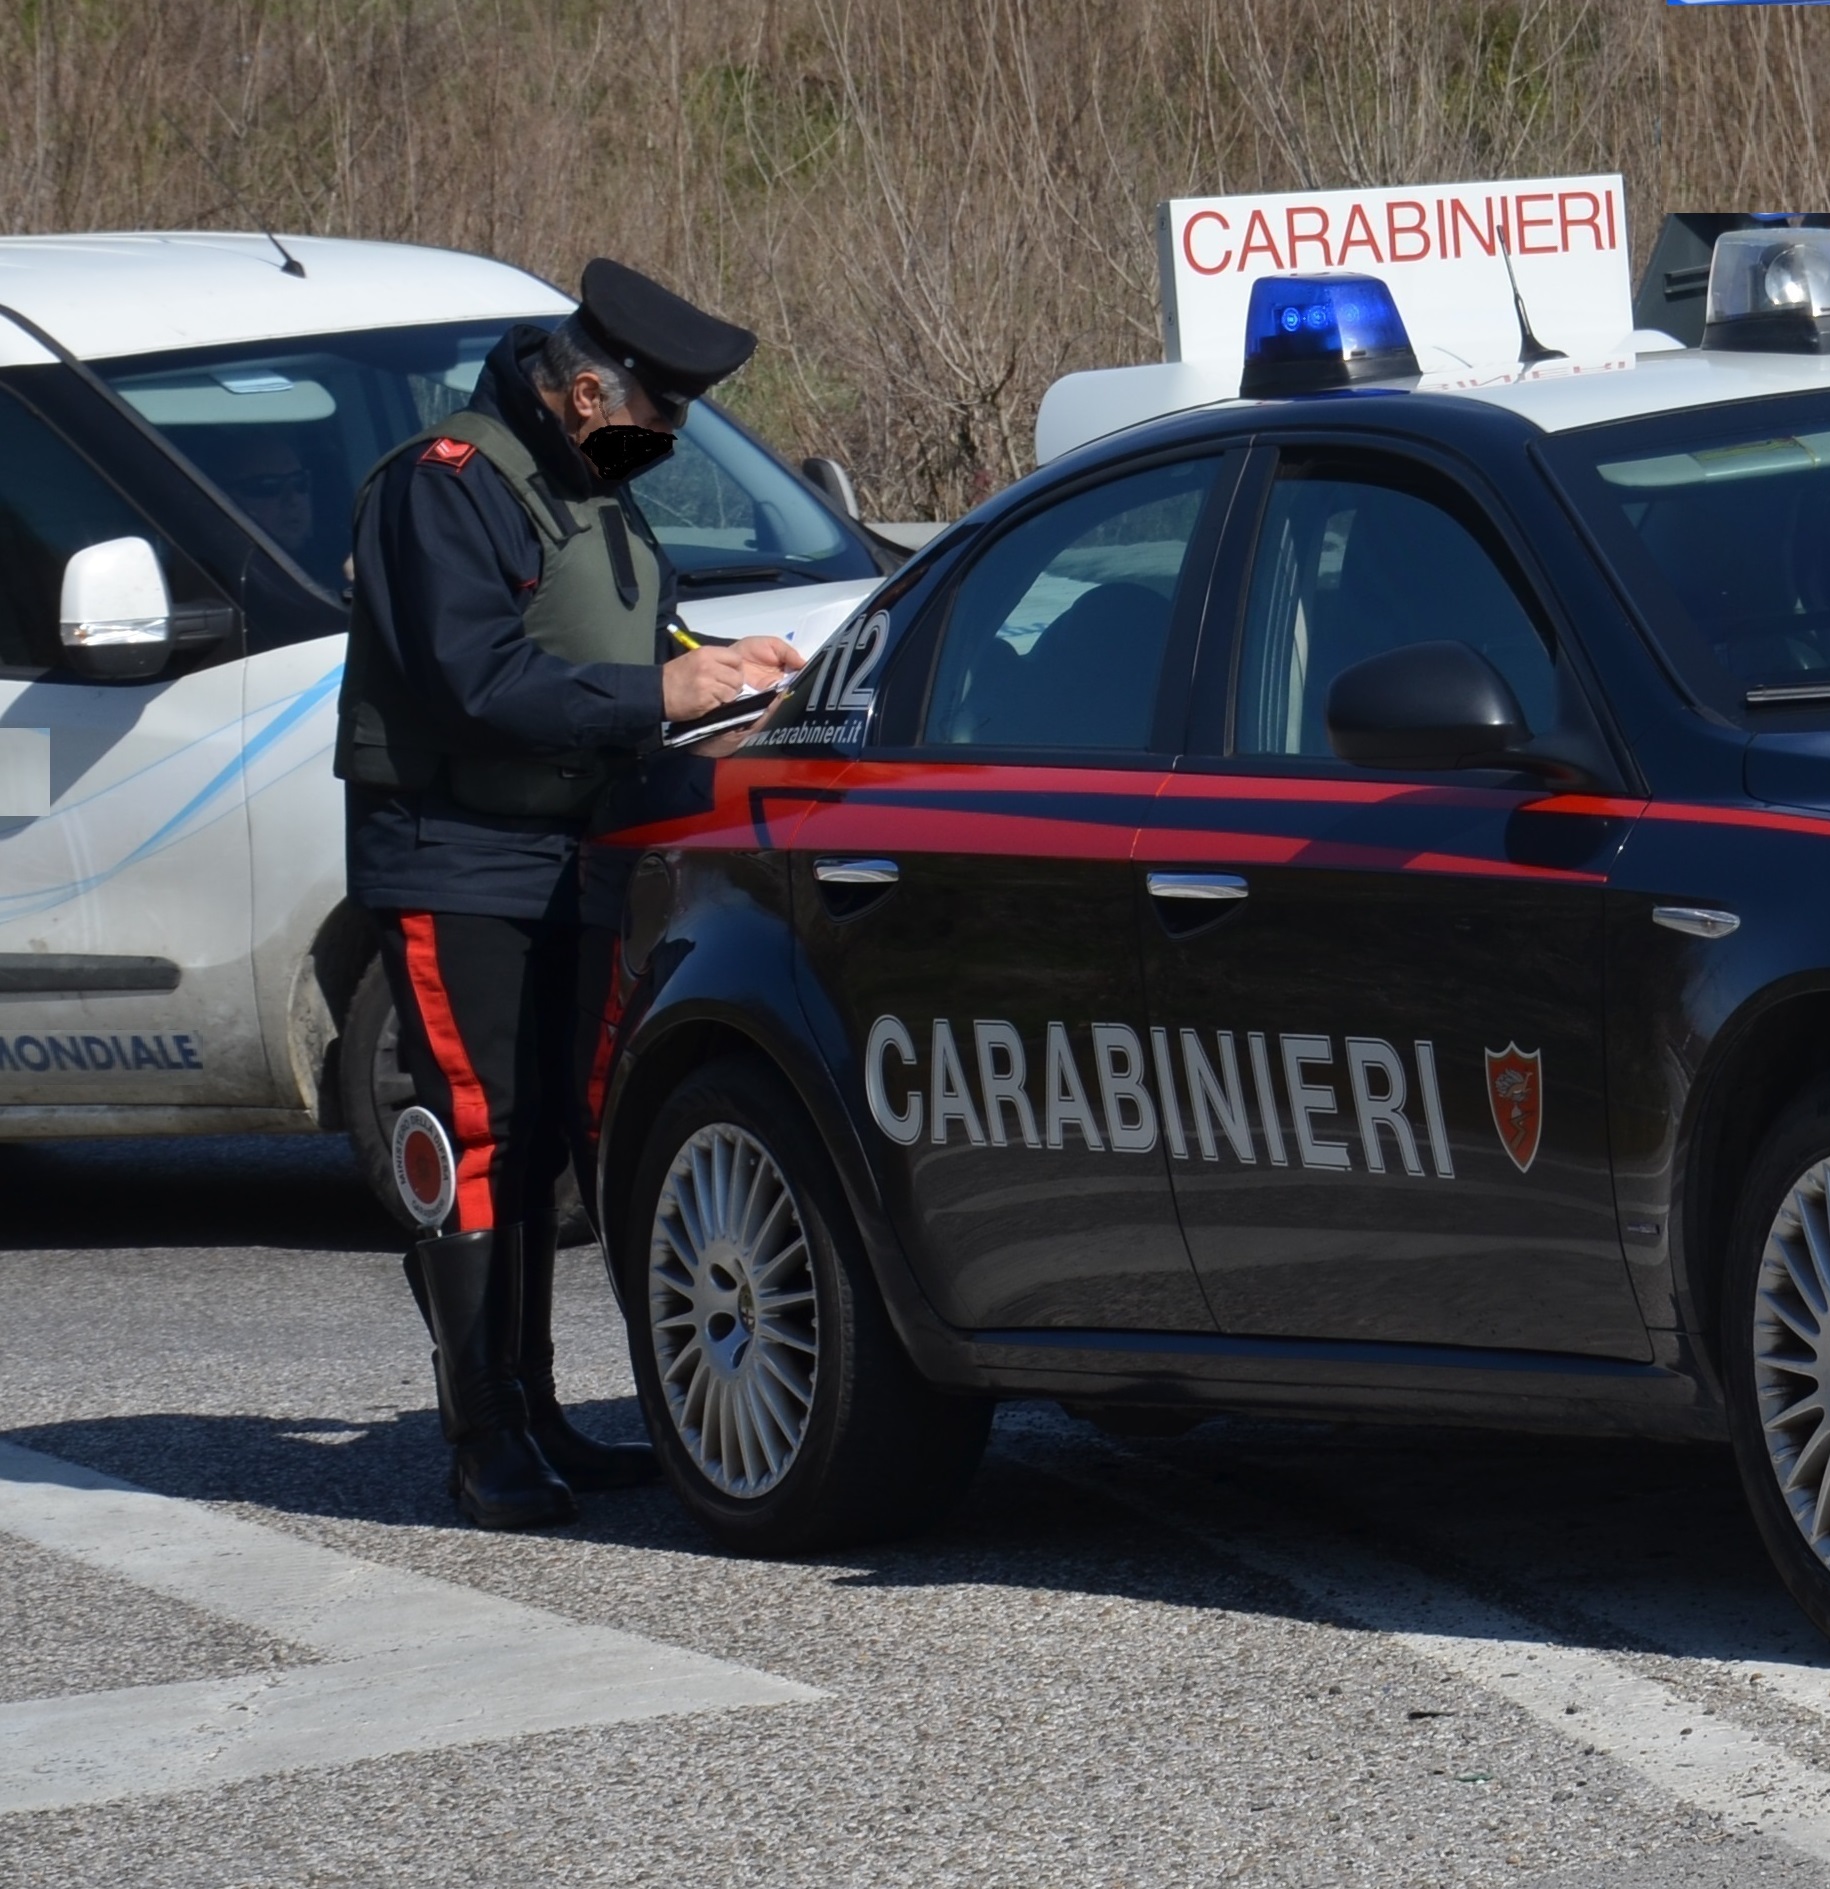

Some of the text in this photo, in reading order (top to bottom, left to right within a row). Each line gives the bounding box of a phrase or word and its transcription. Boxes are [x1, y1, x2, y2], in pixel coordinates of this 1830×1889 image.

[1182, 190, 1617, 275] CARABINIERI
[806, 609, 890, 711] 112
[865, 1014, 1455, 1179] CARABINIERI
